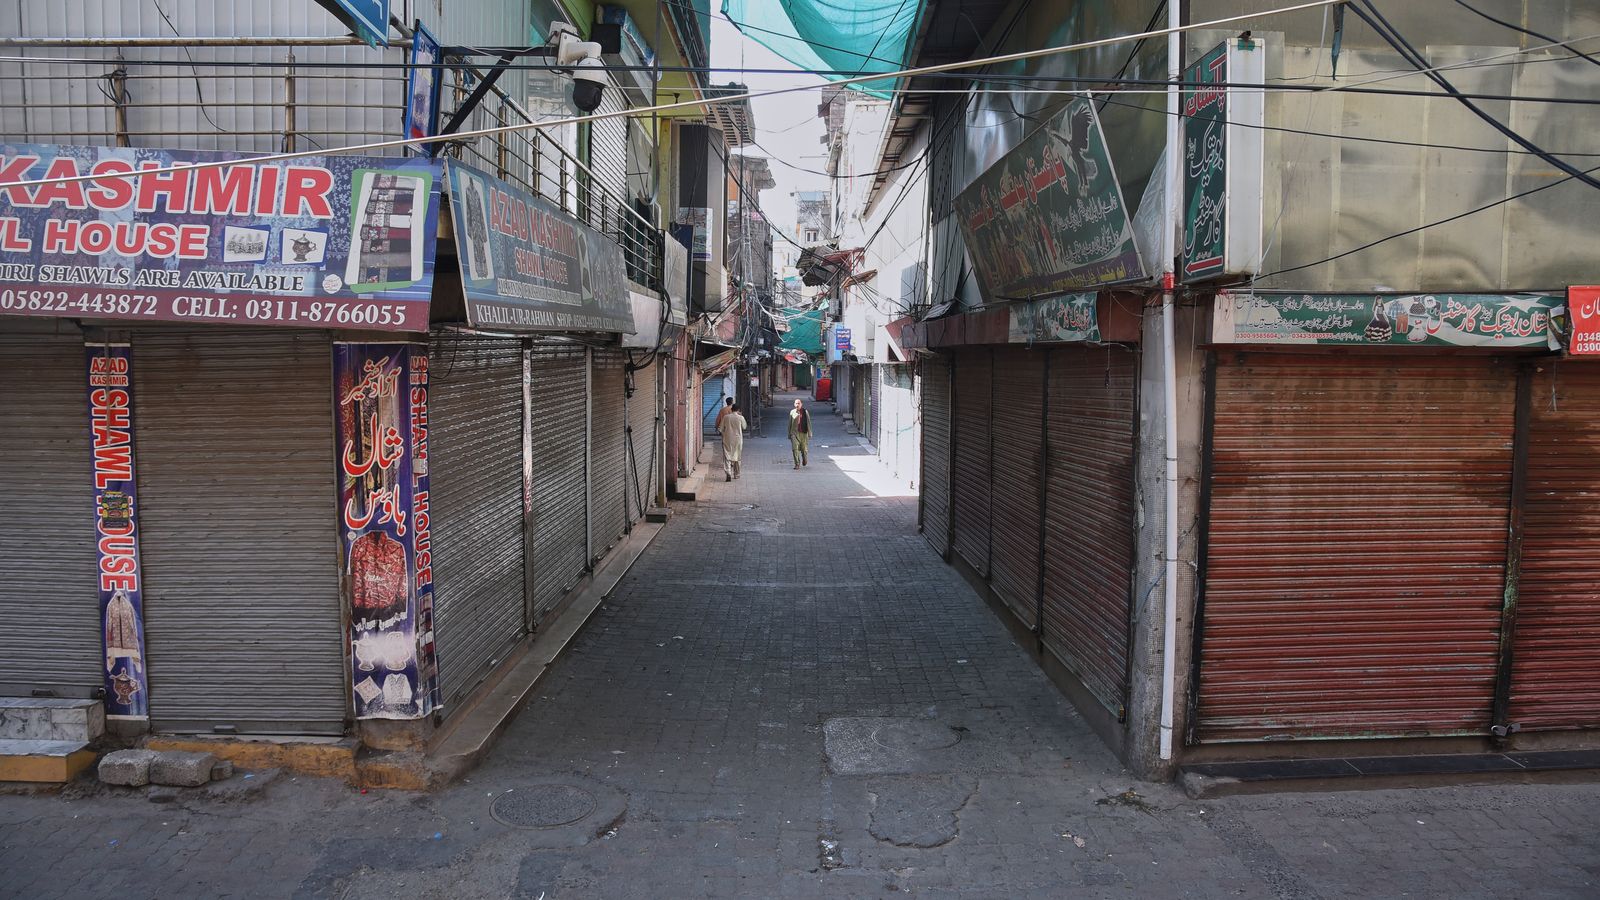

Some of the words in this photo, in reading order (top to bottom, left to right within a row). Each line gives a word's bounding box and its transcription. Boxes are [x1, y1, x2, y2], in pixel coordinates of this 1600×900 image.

[1190, 114, 1225, 187] بوتیک
[0, 155, 334, 219] KASHMIR
[43, 219, 210, 259] HOUSE
[489, 186, 528, 242] AZAD
[529, 205, 577, 260] KASHMIR
[1184, 191, 1226, 259] گارمنٹس
[38, 264, 130, 286] SHAWLS
[134, 269, 180, 288] ARE
[184, 273, 305, 292] AVAILABLE
[514, 246, 545, 280] SHAWL
[544, 255, 569, 285] HOUSE
[1, 289, 157, 316] 05822-443872
[172, 296, 238, 319] CELL:
[245, 299, 407, 326] 0311-8766055
[1426, 296, 1481, 335] گارمنٹس
[1480, 304, 1519, 340] بوتیک
[89, 374, 129, 387] KASHMIR
[90, 357, 129, 375] AZAD
[341, 356, 390, 405] کشمیر
[368, 366, 402, 398] آزاد
[90, 389, 133, 489] SHAWL
[343, 412, 404, 477] شال
[345, 484, 406, 537] ہاؤس
[413, 490, 433, 590] HOUSE
